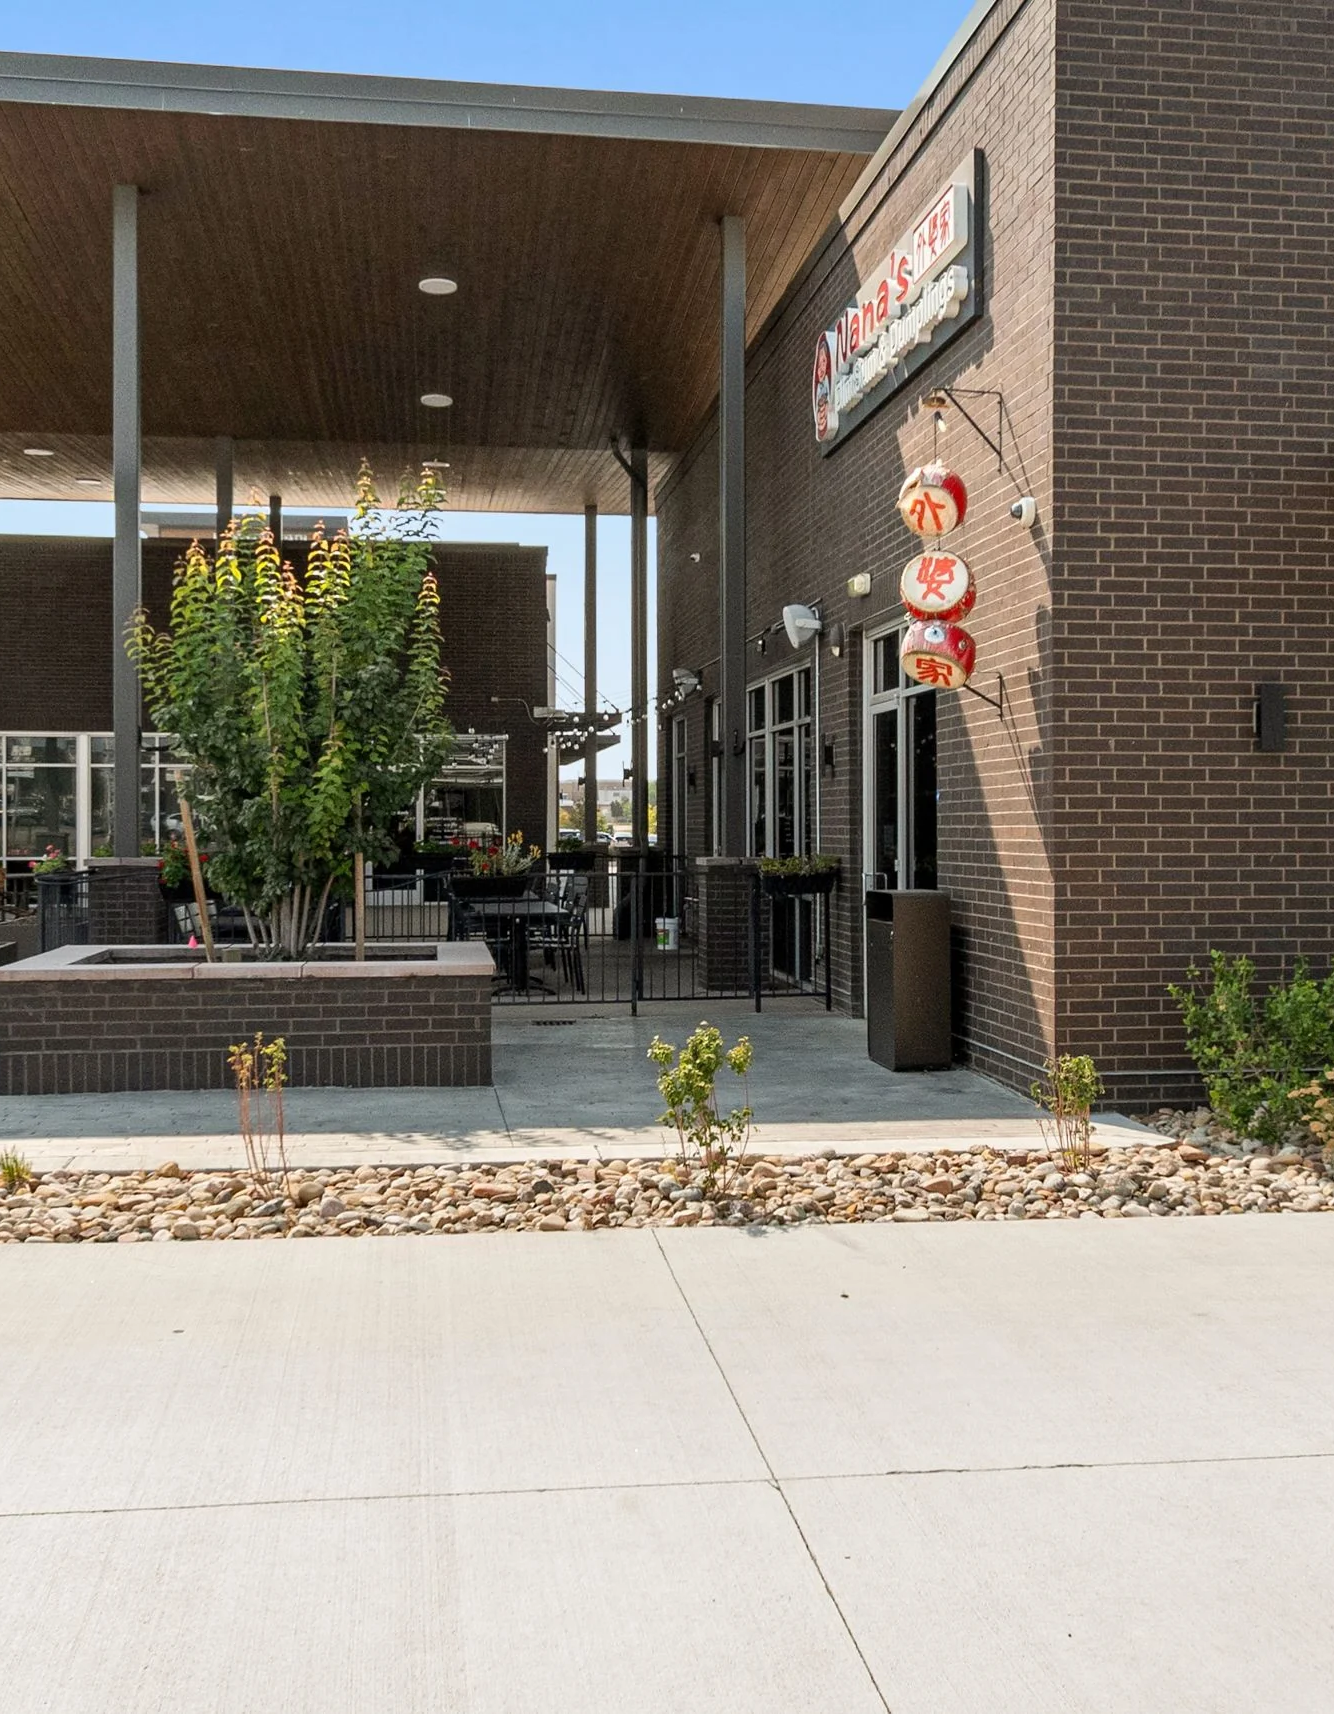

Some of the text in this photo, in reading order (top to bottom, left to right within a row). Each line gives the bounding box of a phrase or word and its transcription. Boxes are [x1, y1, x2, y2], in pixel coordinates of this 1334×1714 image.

[835, 251, 909, 373] Nana's
[909, 490, 946, 531] 外
[915, 555, 958, 601] 婆
[915, 657, 953, 687] 家
